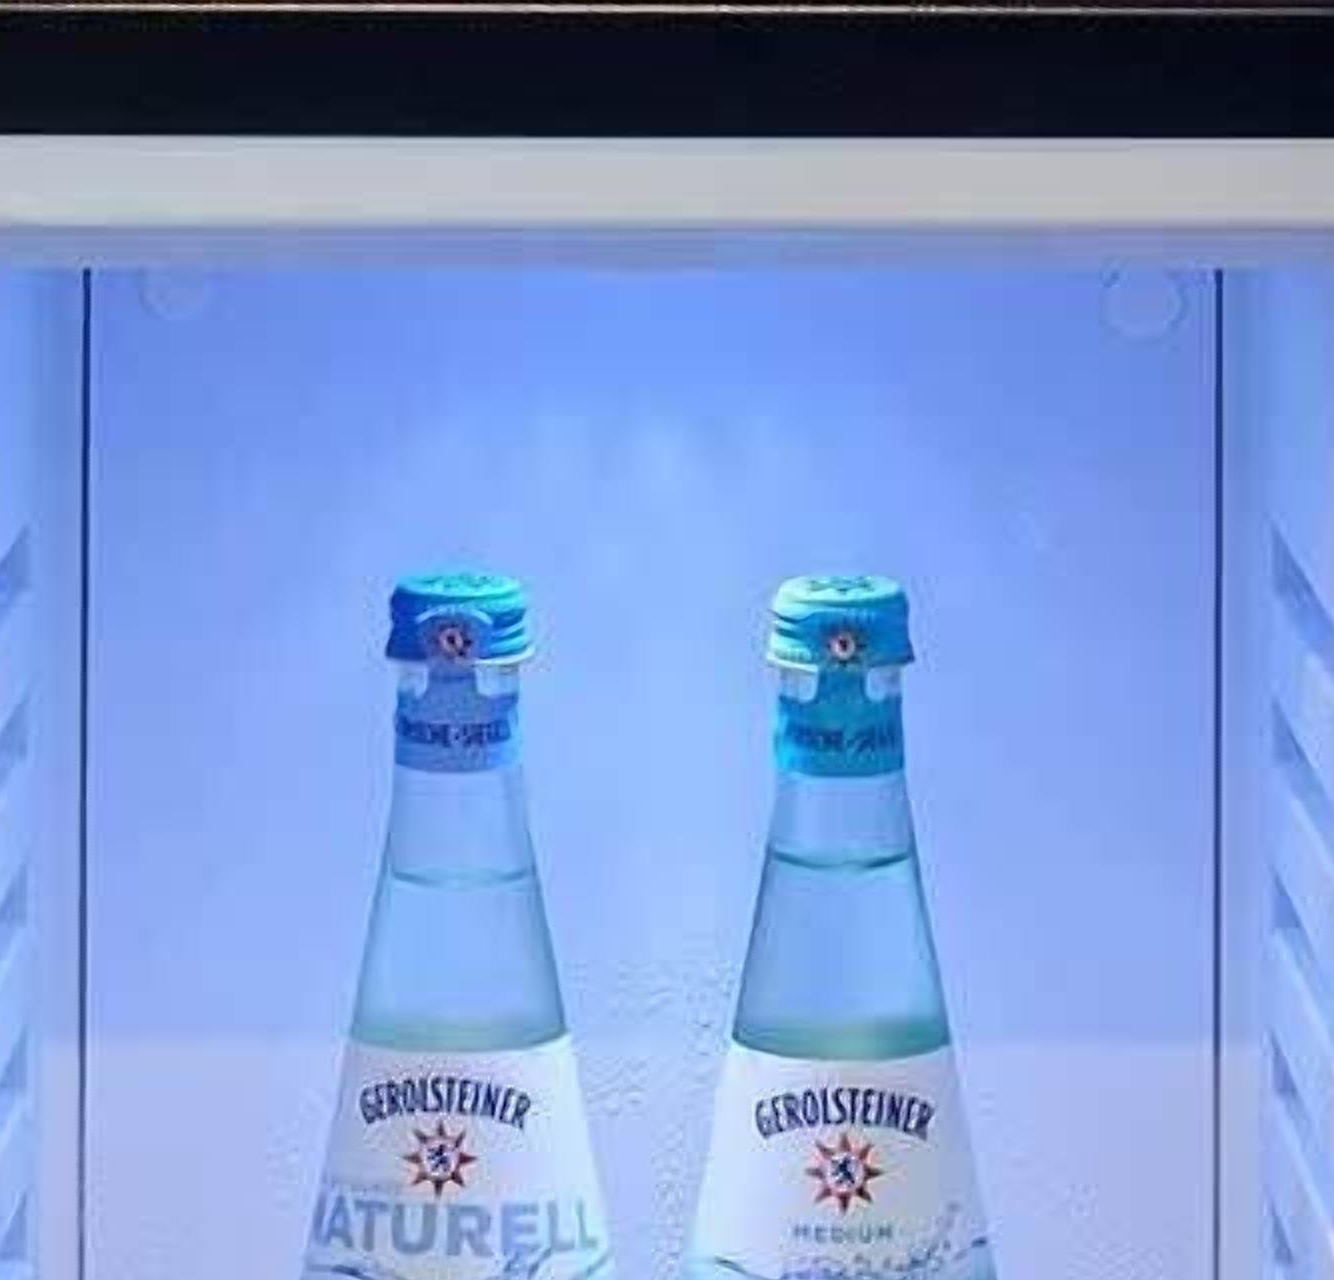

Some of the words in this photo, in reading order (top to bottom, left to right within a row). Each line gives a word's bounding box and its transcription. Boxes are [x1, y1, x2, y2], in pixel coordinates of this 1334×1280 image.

[359, 1075, 531, 1130] GEROLSTEINER
[754, 1087, 936, 1141] GEROLSTEINER
[793, 1224, 893, 1244] MEDIUM
